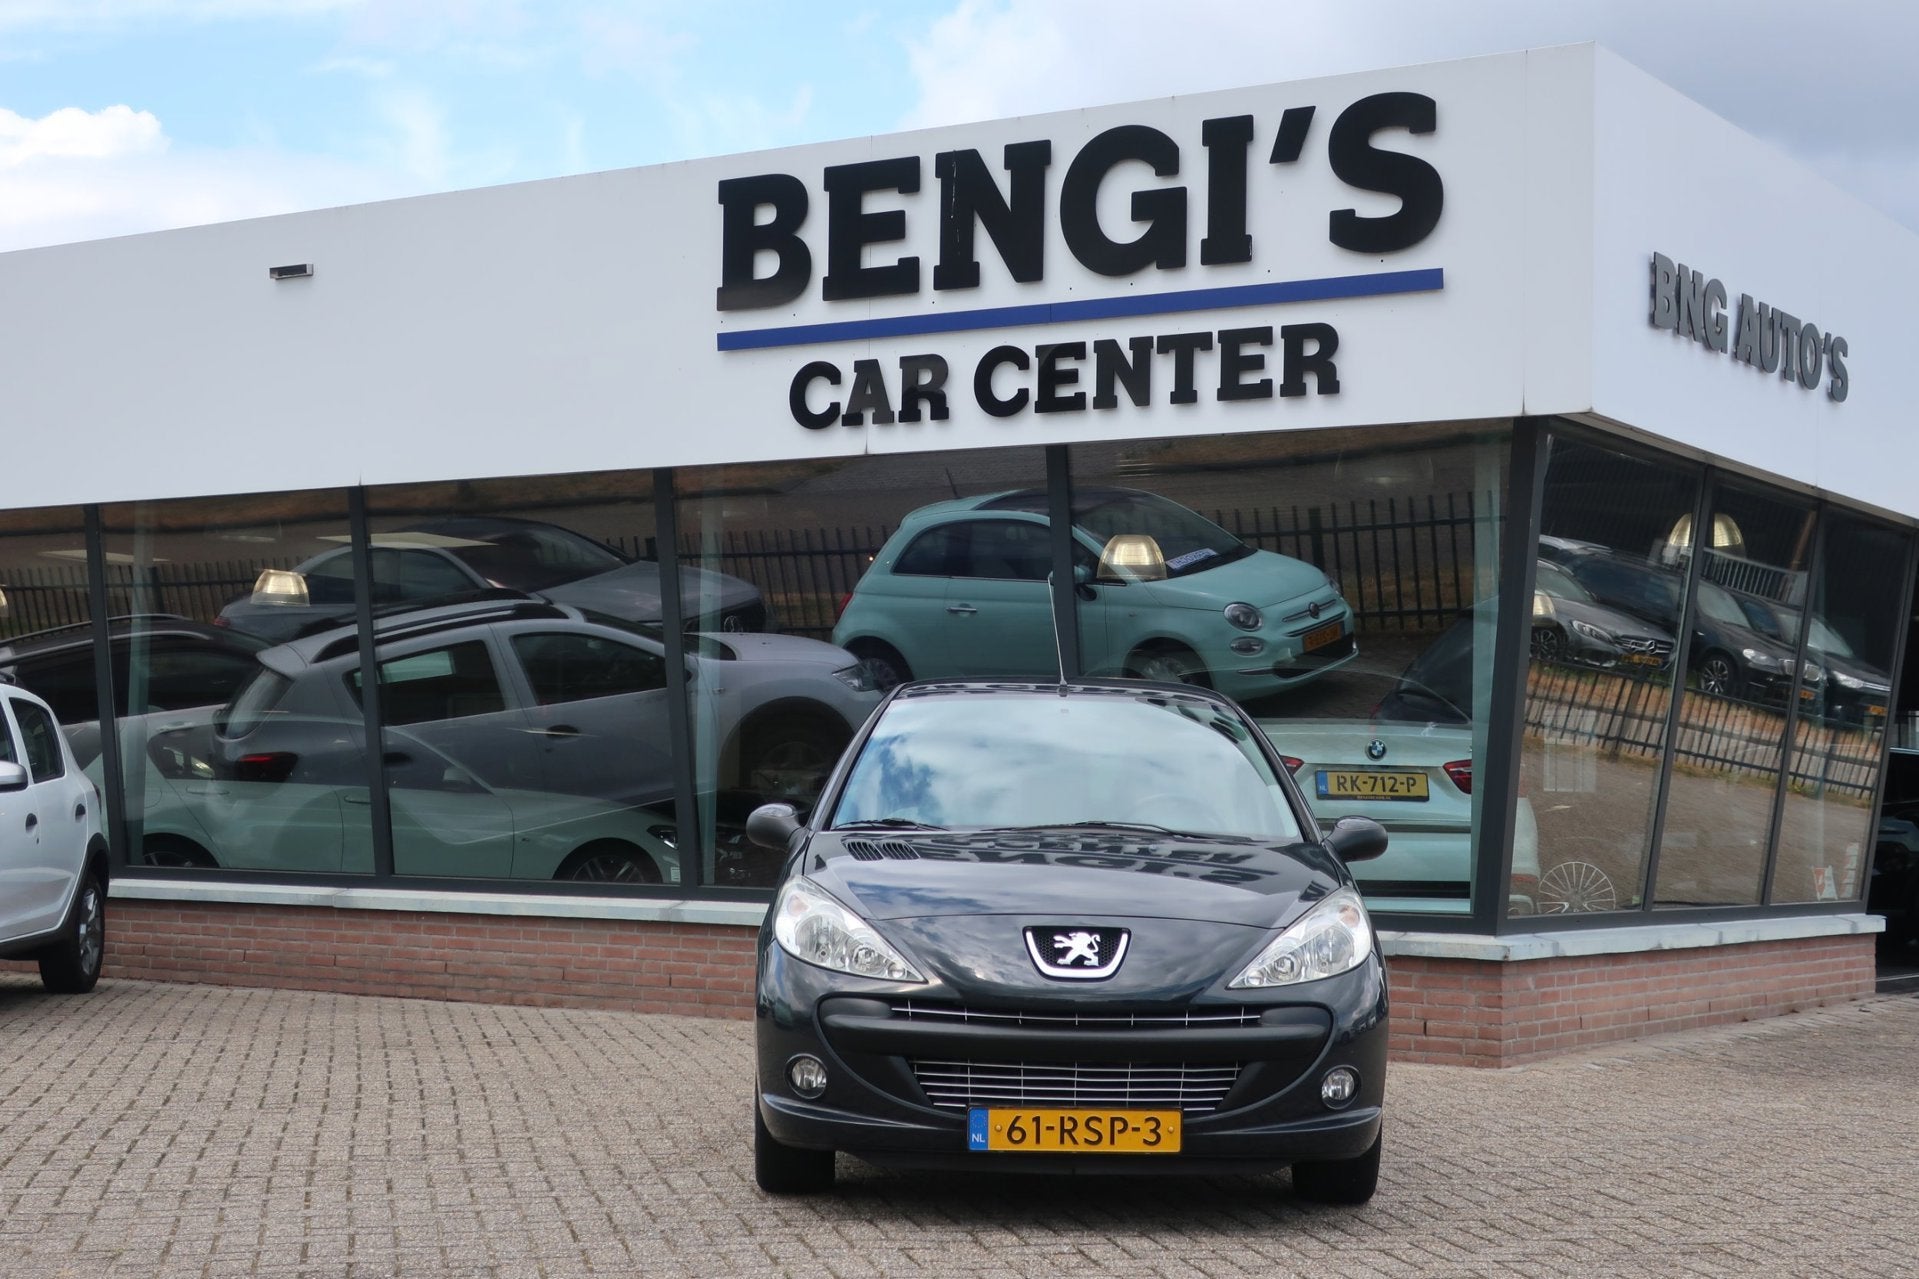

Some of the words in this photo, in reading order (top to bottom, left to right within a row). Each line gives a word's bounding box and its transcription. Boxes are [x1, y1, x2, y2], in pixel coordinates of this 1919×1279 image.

[717, 91, 1444, 311] BENGI'S
[1652, 251, 1728, 354] BNG
[1734, 293, 1849, 403] AUTO'S
[789, 353, 950, 430] CAR
[973, 322, 1340, 418] CENTER
[1336, 775, 1417, 793] RK-712-P
[971, 1133, 985, 1143] NL
[1006, 1115, 1162, 1146] 61-RSP-3
